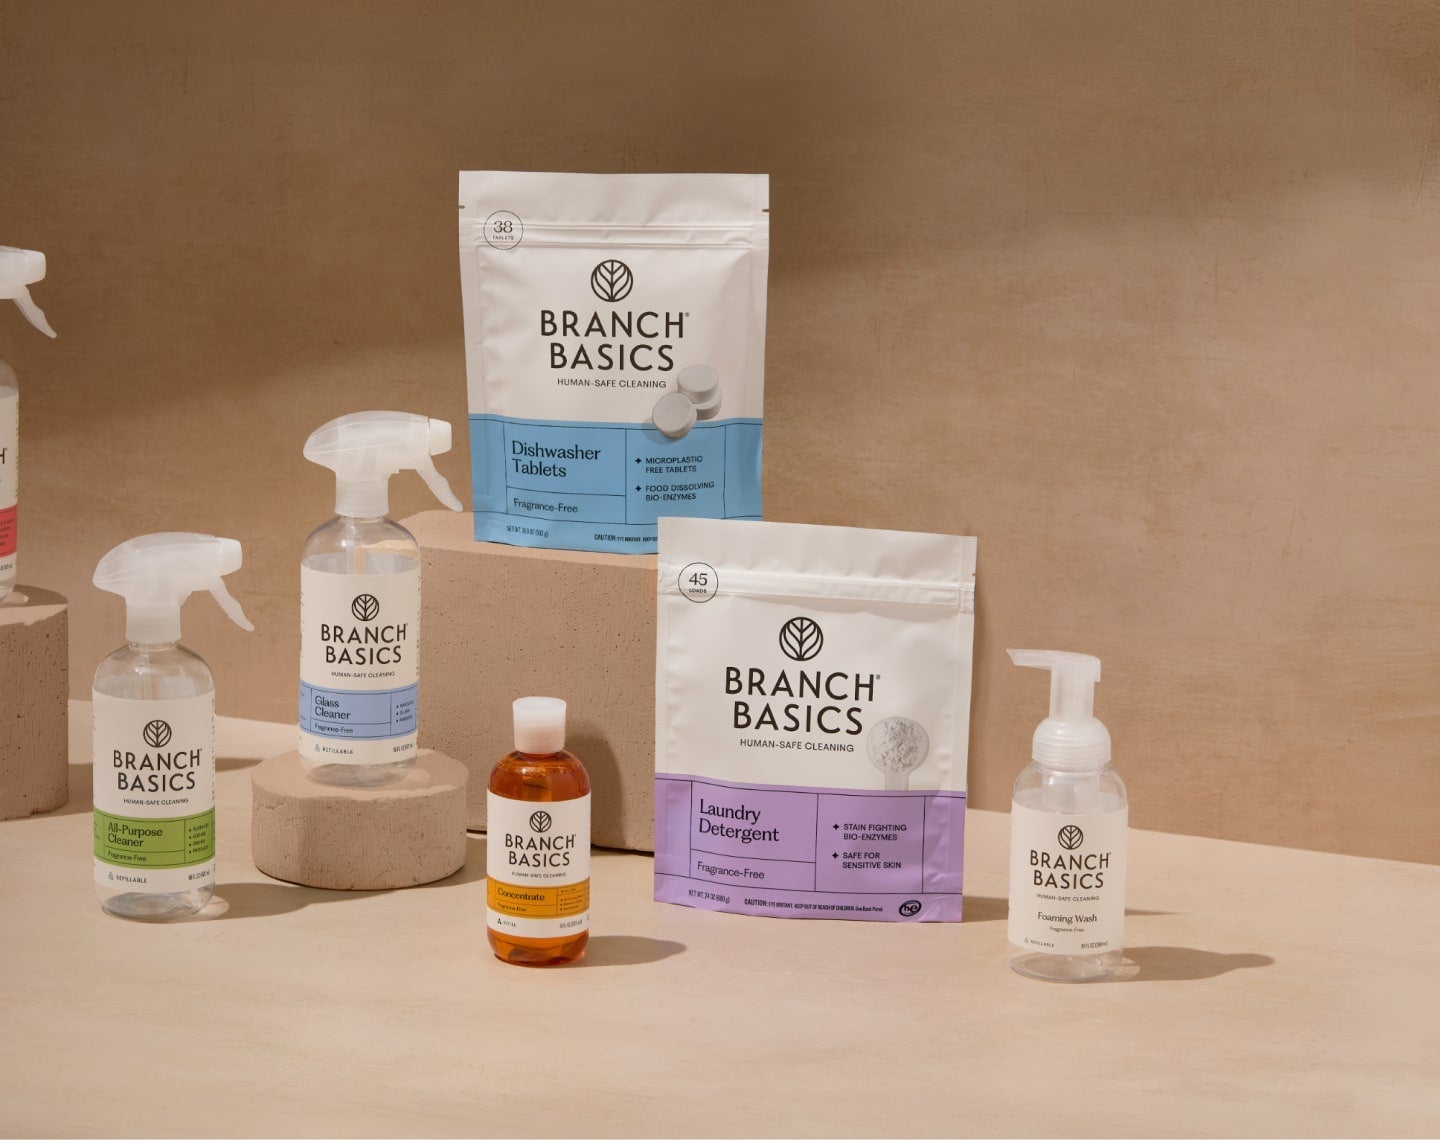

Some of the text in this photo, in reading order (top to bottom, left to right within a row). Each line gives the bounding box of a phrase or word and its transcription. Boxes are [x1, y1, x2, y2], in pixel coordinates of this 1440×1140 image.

[493, 220, 513, 233] 38
[550, 342, 674, 371] BASICS
[557, 378, 667, 389] HUMAN-SAFE CLEANING
[512, 440, 601, 460] Dishwasher
[645, 455, 703, 464] MICROPLASTIC
[512, 458, 567, 477] Tablets
[645, 465, 697, 474] FREE TABLETS
[671, 481, 715, 491] DISSOLVING
[645, 493, 697, 501] BIO-ENZYMES
[513, 498, 578, 513] Fragrance-Free
[688, 573, 708, 586] 45
[325, 645, 402, 665] BASICS
[315, 695, 340, 708] Glass
[315, 706, 351, 720] Cleaner
[733, 701, 863, 736] BASICS
[740, 738, 855, 752] HUMAN-SAFE CLEANING
[117, 771, 196, 793] BASICS
[700, 798, 761, 825] Laundry
[108, 821, 163, 838] All-Purpose
[699, 817, 780, 844] Detergent
[843, 823, 866, 831] STAIN
[108, 833, 144, 847] Cleaner
[843, 833, 898, 841] BIO-ENZYMES
[508, 850, 570, 868] BASICS
[842, 861, 902, 869] SENSITIVE SKIN
[697, 861, 765, 879] Fragrance-Free
[1033, 869, 1104, 890] BASICS
[497, 888, 545, 901] Concentrate
[1037, 911, 1098, 925] Foaming Wash
